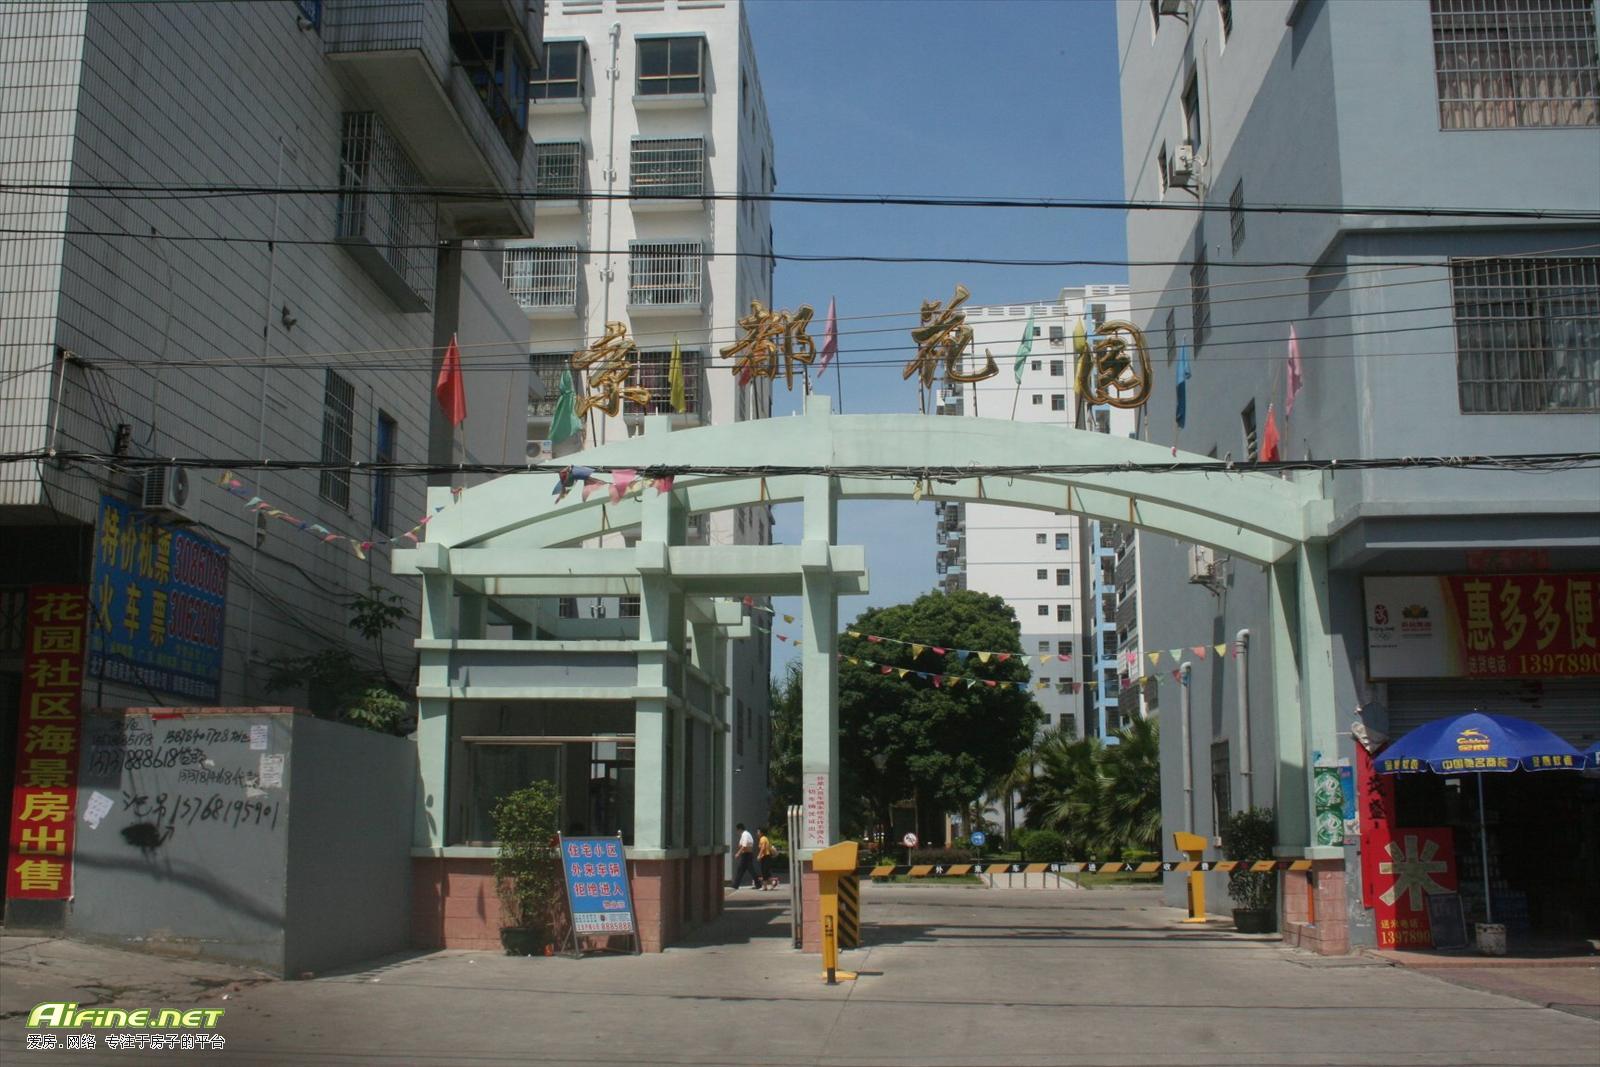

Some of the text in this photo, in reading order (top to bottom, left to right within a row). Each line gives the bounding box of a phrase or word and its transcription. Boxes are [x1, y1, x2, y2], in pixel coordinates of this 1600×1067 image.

[101, 504, 172, 585] 特价机票
[95, 574, 168, 647] 火车票
[1464, 578, 1600, 651] 惠多多便
[15, 592, 85, 892] 花园社区海景房出售
[568, 842, 619, 858] 住宅小区
[571, 862, 621, 878] 外来车辆
[1378, 835, 1457, 912] 米
